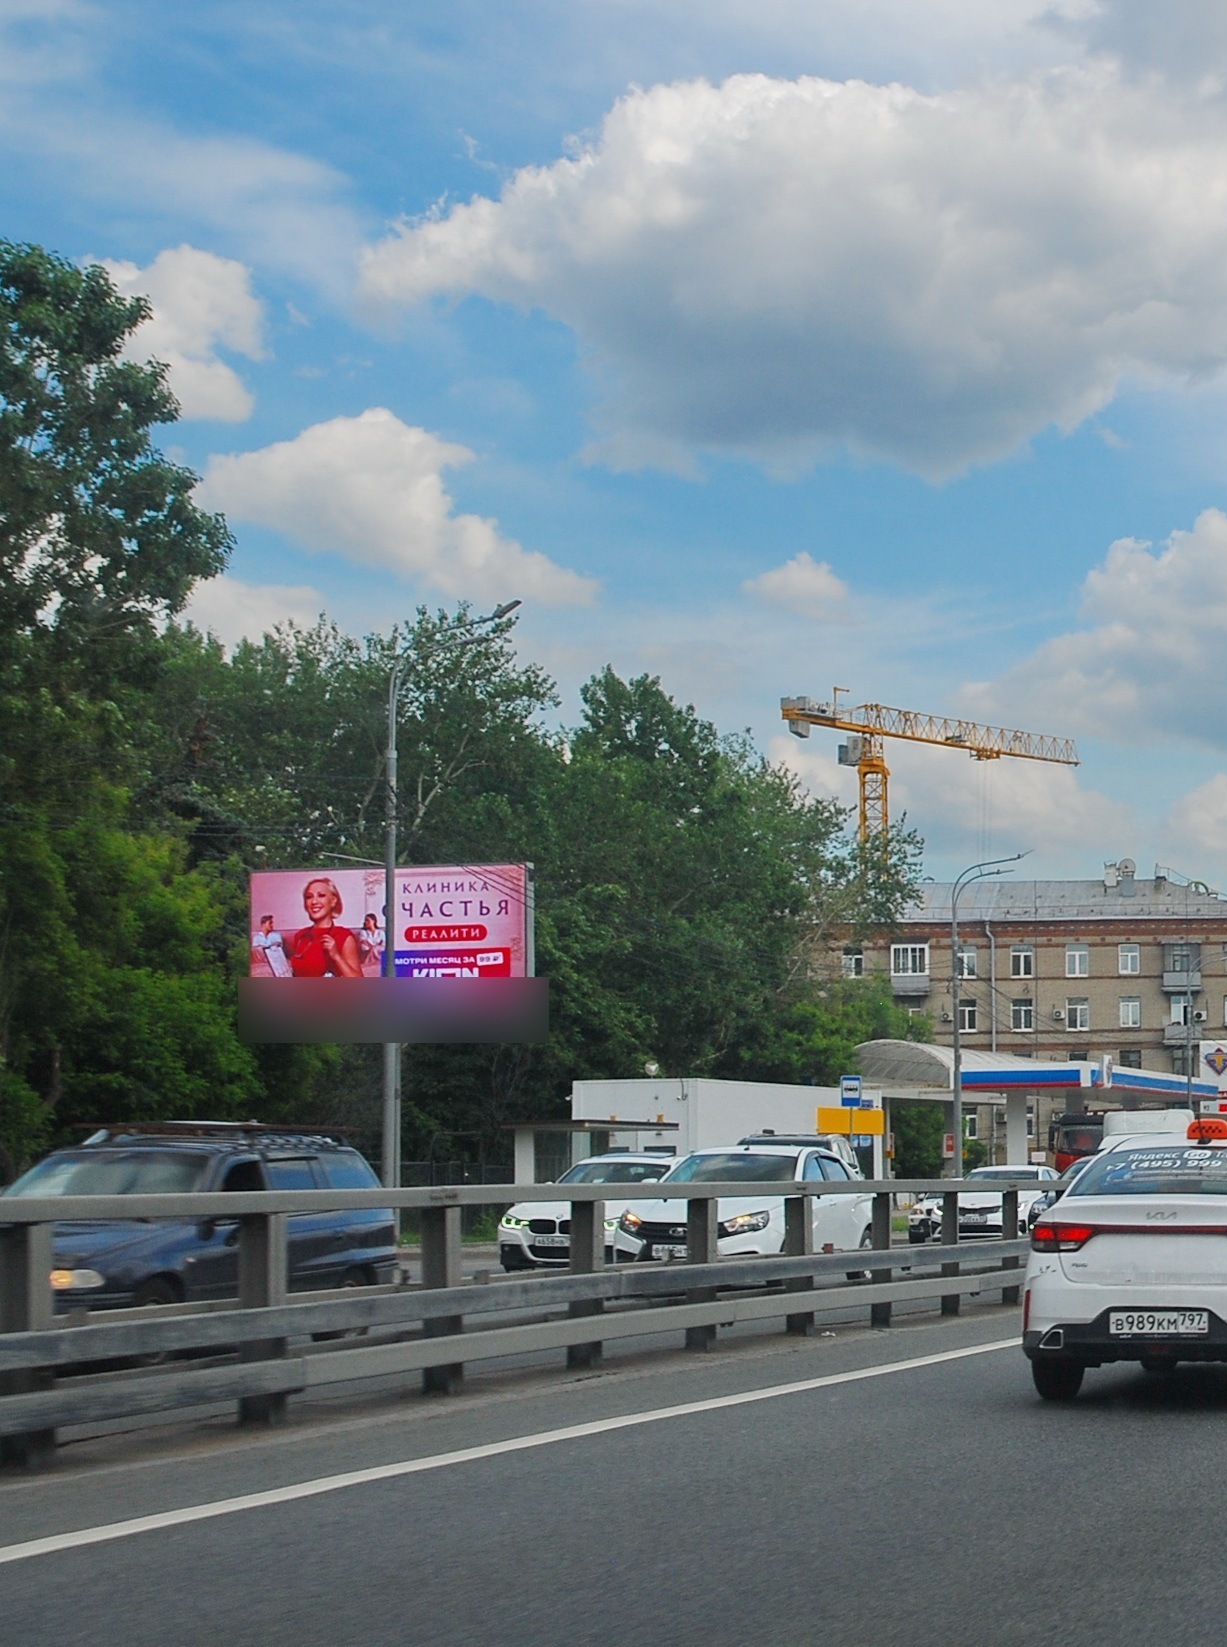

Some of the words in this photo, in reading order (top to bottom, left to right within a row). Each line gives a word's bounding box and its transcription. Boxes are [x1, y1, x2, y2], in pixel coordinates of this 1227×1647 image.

[402, 881, 490, 894] КЛИНИКА
[412, 927, 481, 939] РЕАЛИТИ
[395, 955, 428, 965] МОТРИ
[429, 956, 462, 966] МЕСЯЦ
[463, 955, 476, 964] ЗА
[1127, 1152, 1181, 1161] Яндекс
[1130, 1159, 1181, 1170] (495)
[1186, 1159, 1222, 1167] 999
[1179, 1313, 1203, 1326] 797
